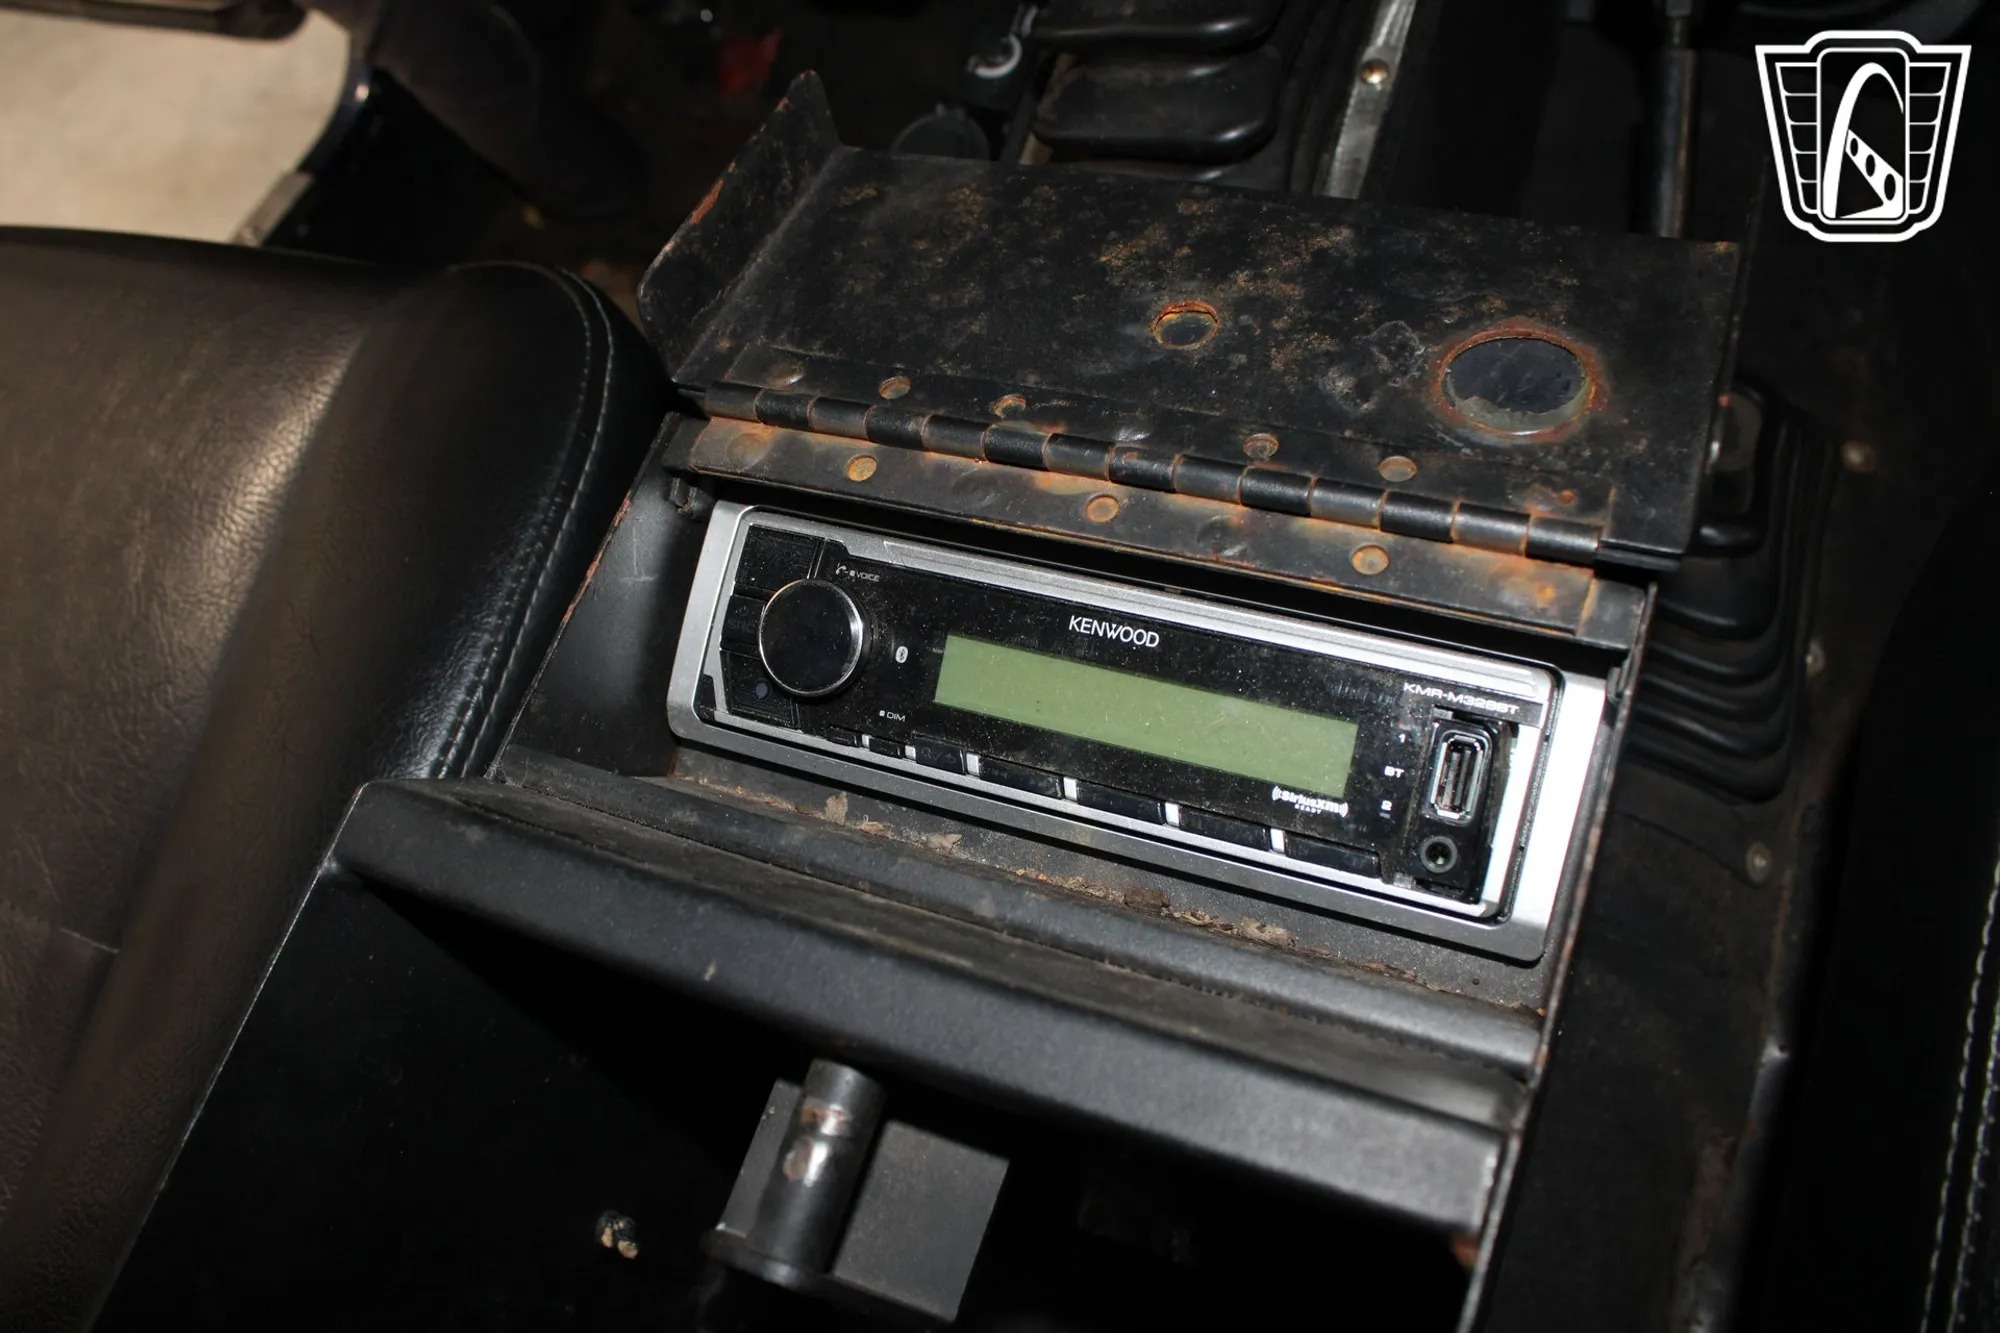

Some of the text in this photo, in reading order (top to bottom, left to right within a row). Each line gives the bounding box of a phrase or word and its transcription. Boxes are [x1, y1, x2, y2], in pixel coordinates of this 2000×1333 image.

[857, 571, 881, 582] VOICE
[1069, 615, 1160, 648] KENWOOD
[887, 711, 907, 723] DIM
[1384, 765, 1404, 779] BT
[1380, 799, 1392, 811] 2
